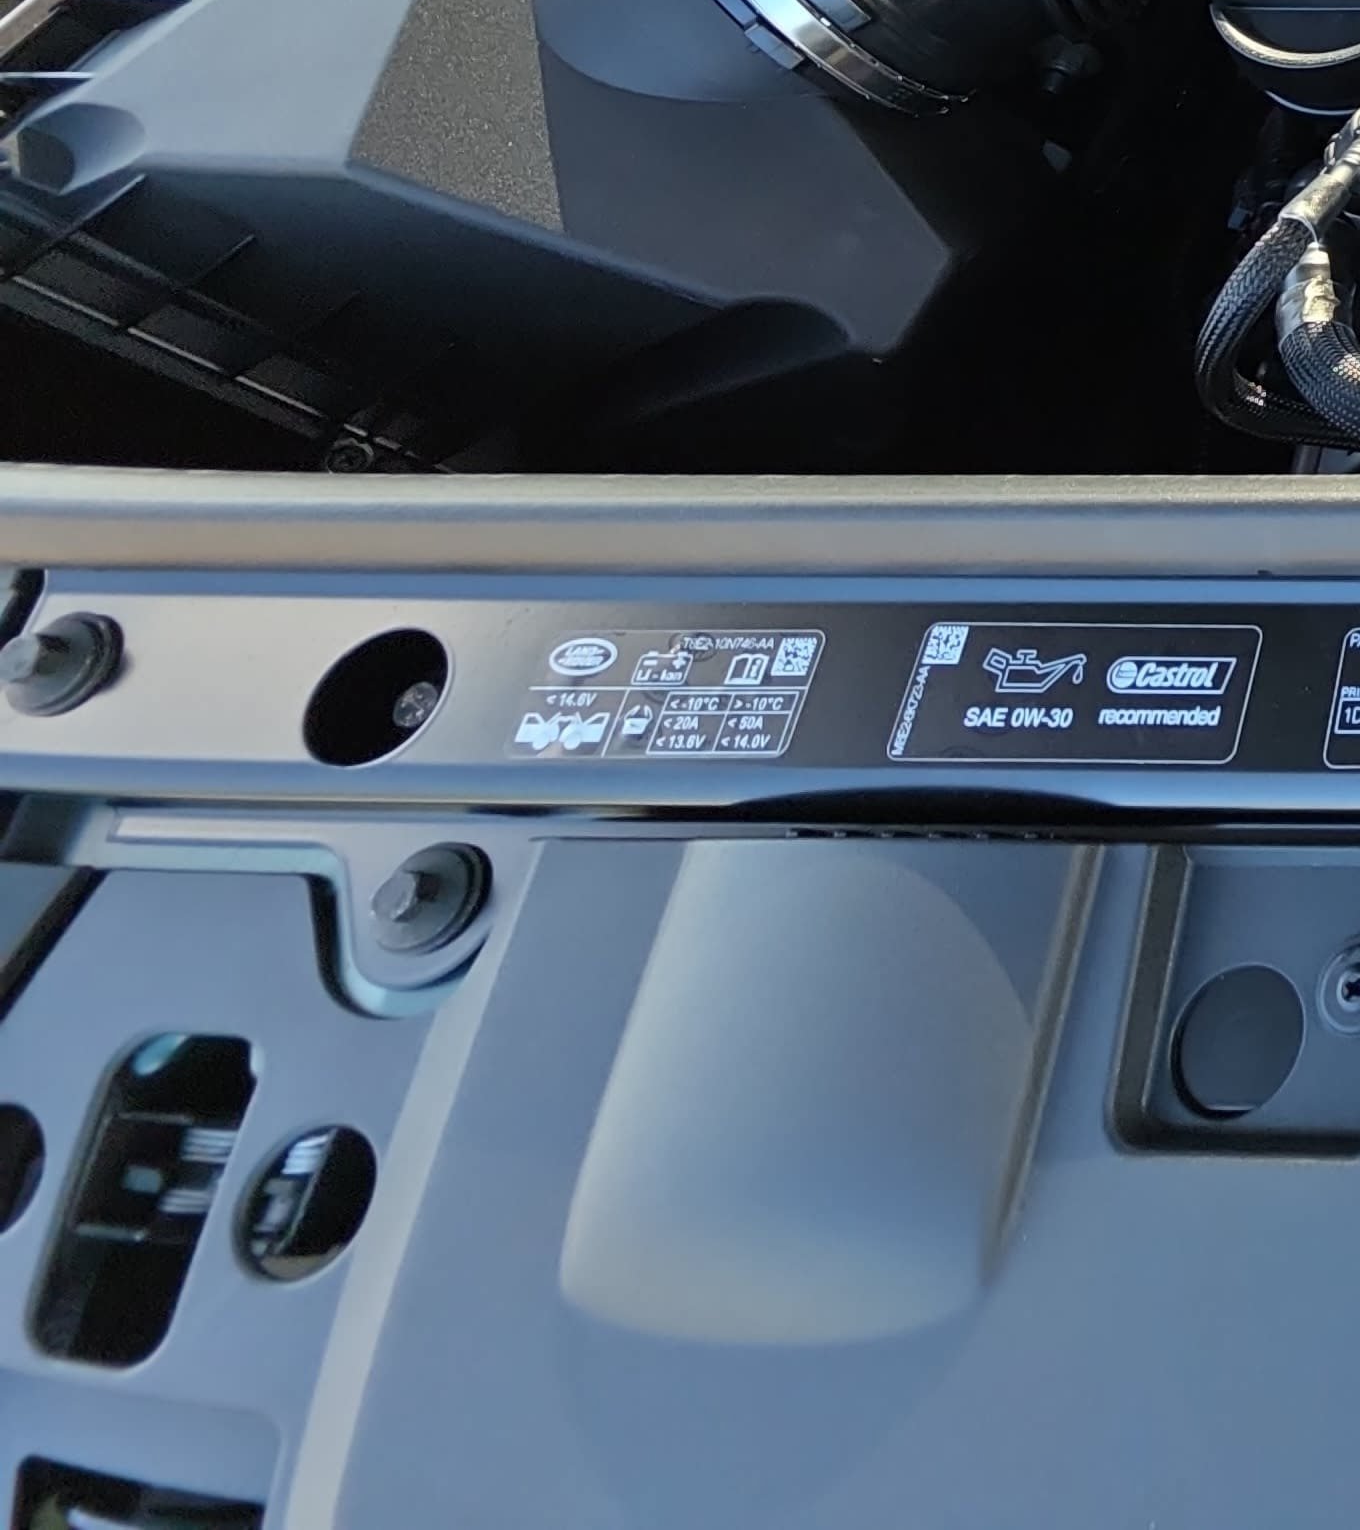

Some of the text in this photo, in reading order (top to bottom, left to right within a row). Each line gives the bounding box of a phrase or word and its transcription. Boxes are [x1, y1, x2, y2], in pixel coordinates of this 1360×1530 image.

[1134, 661, 1219, 687] Castrol
[963, 707, 1074, 728] SAE 0W-30
[1098, 706, 1221, 727] recommended
